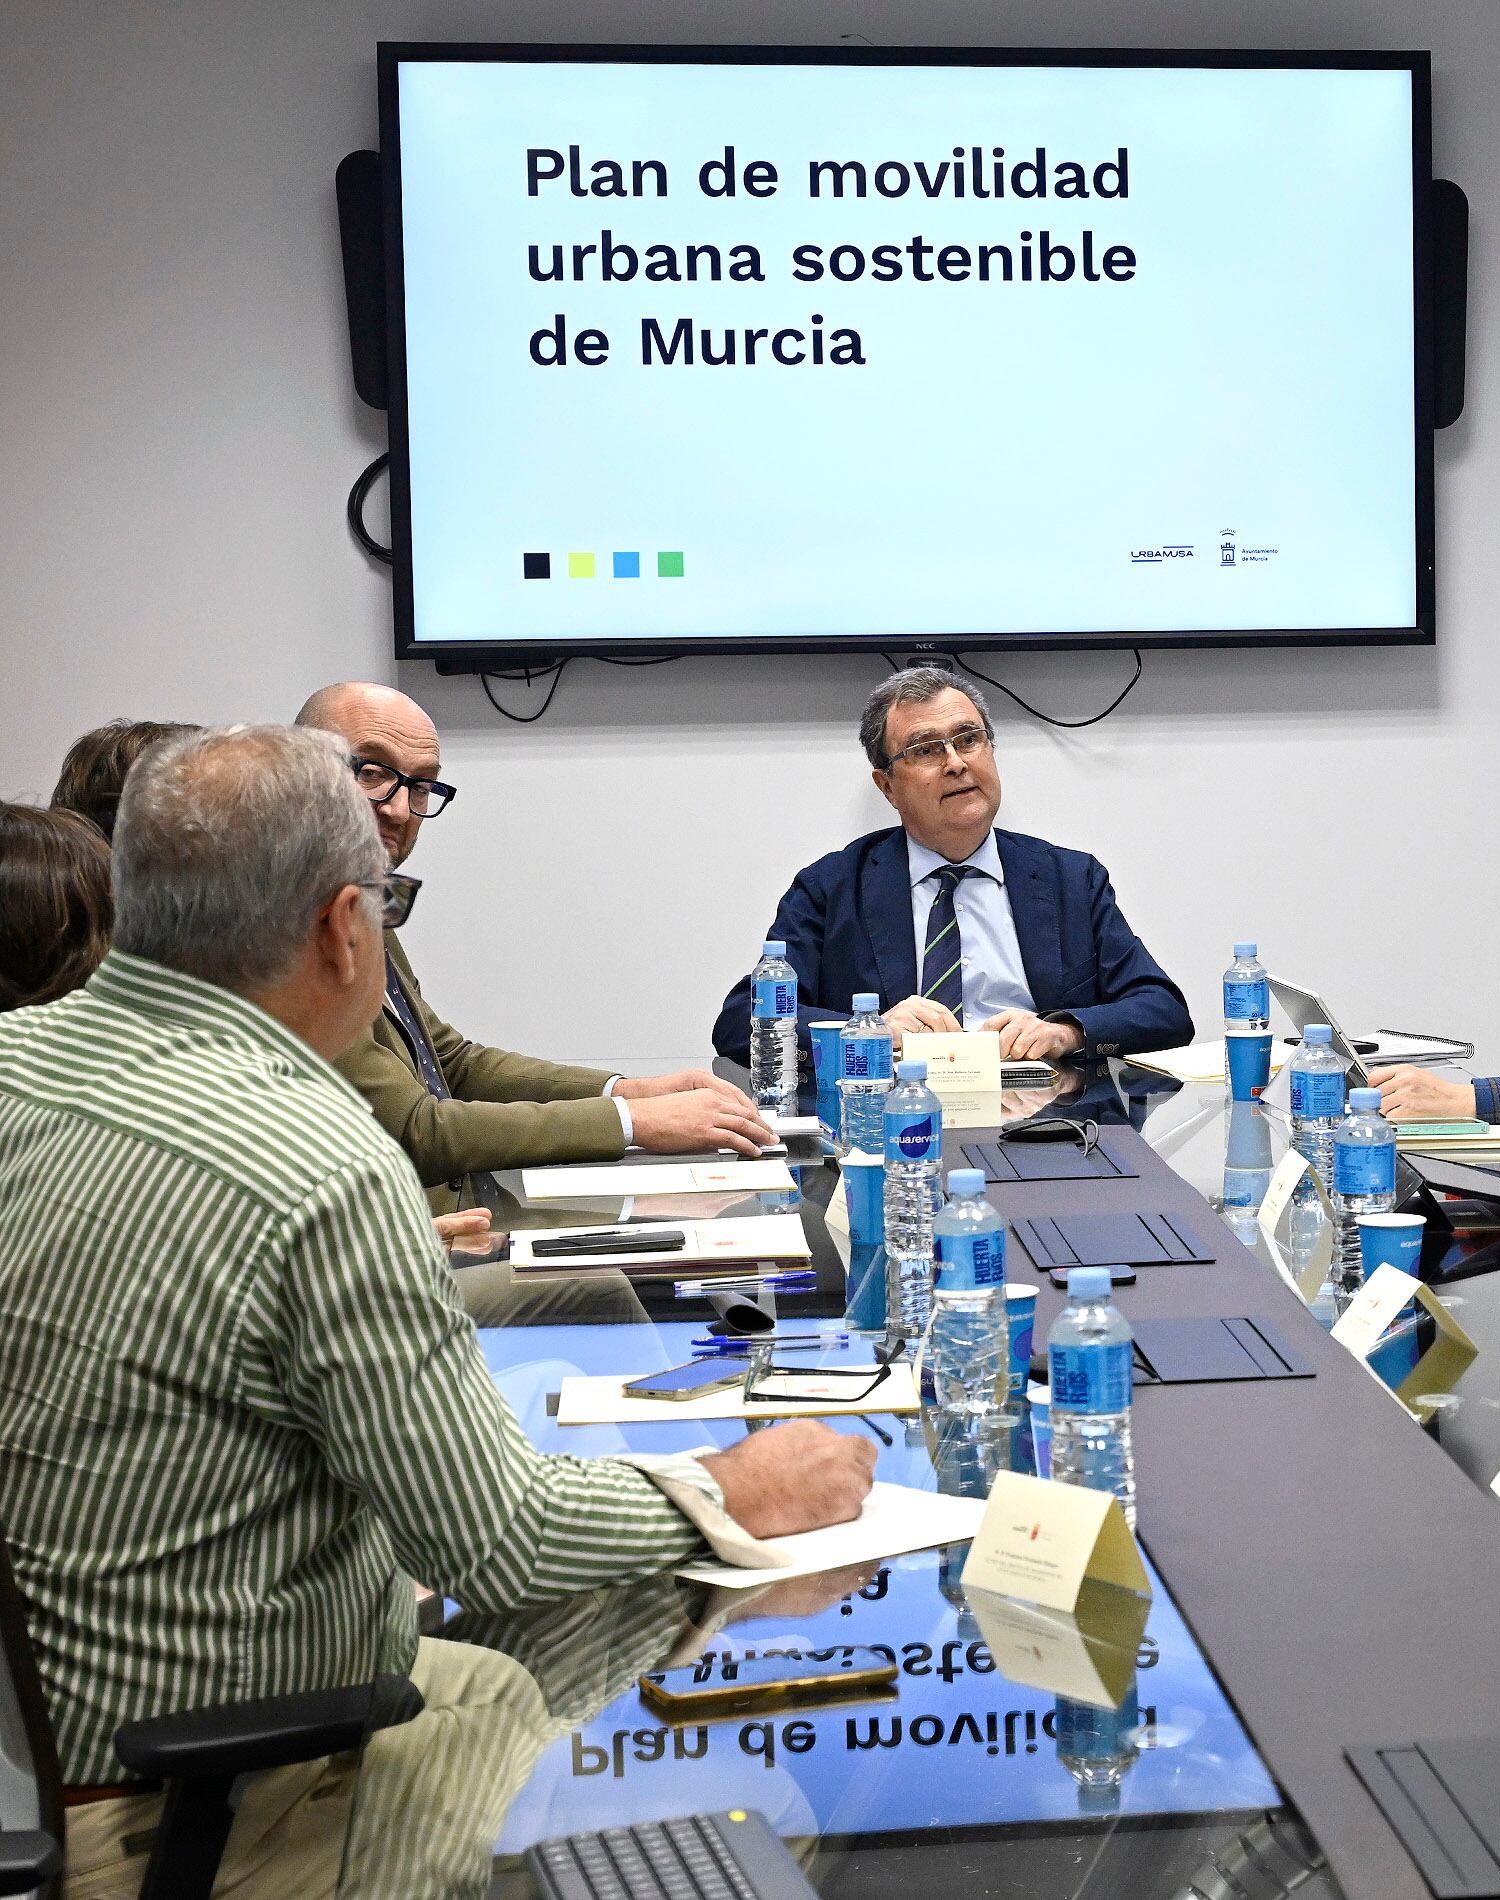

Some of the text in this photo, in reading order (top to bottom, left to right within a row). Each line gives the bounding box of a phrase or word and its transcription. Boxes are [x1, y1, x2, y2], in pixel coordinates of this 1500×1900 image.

[526, 145, 1129, 199] Plan de movilidad
[528, 230, 1137, 282] urbana sostenible
[529, 314, 867, 366] de Murcia
[1131, 550, 1194, 558] URBAMUSA
[775, 984, 787, 1015] HUERTA
[845, 1043, 856, 1076] HUERTA
[973, 1239, 992, 1285] HUERTA
